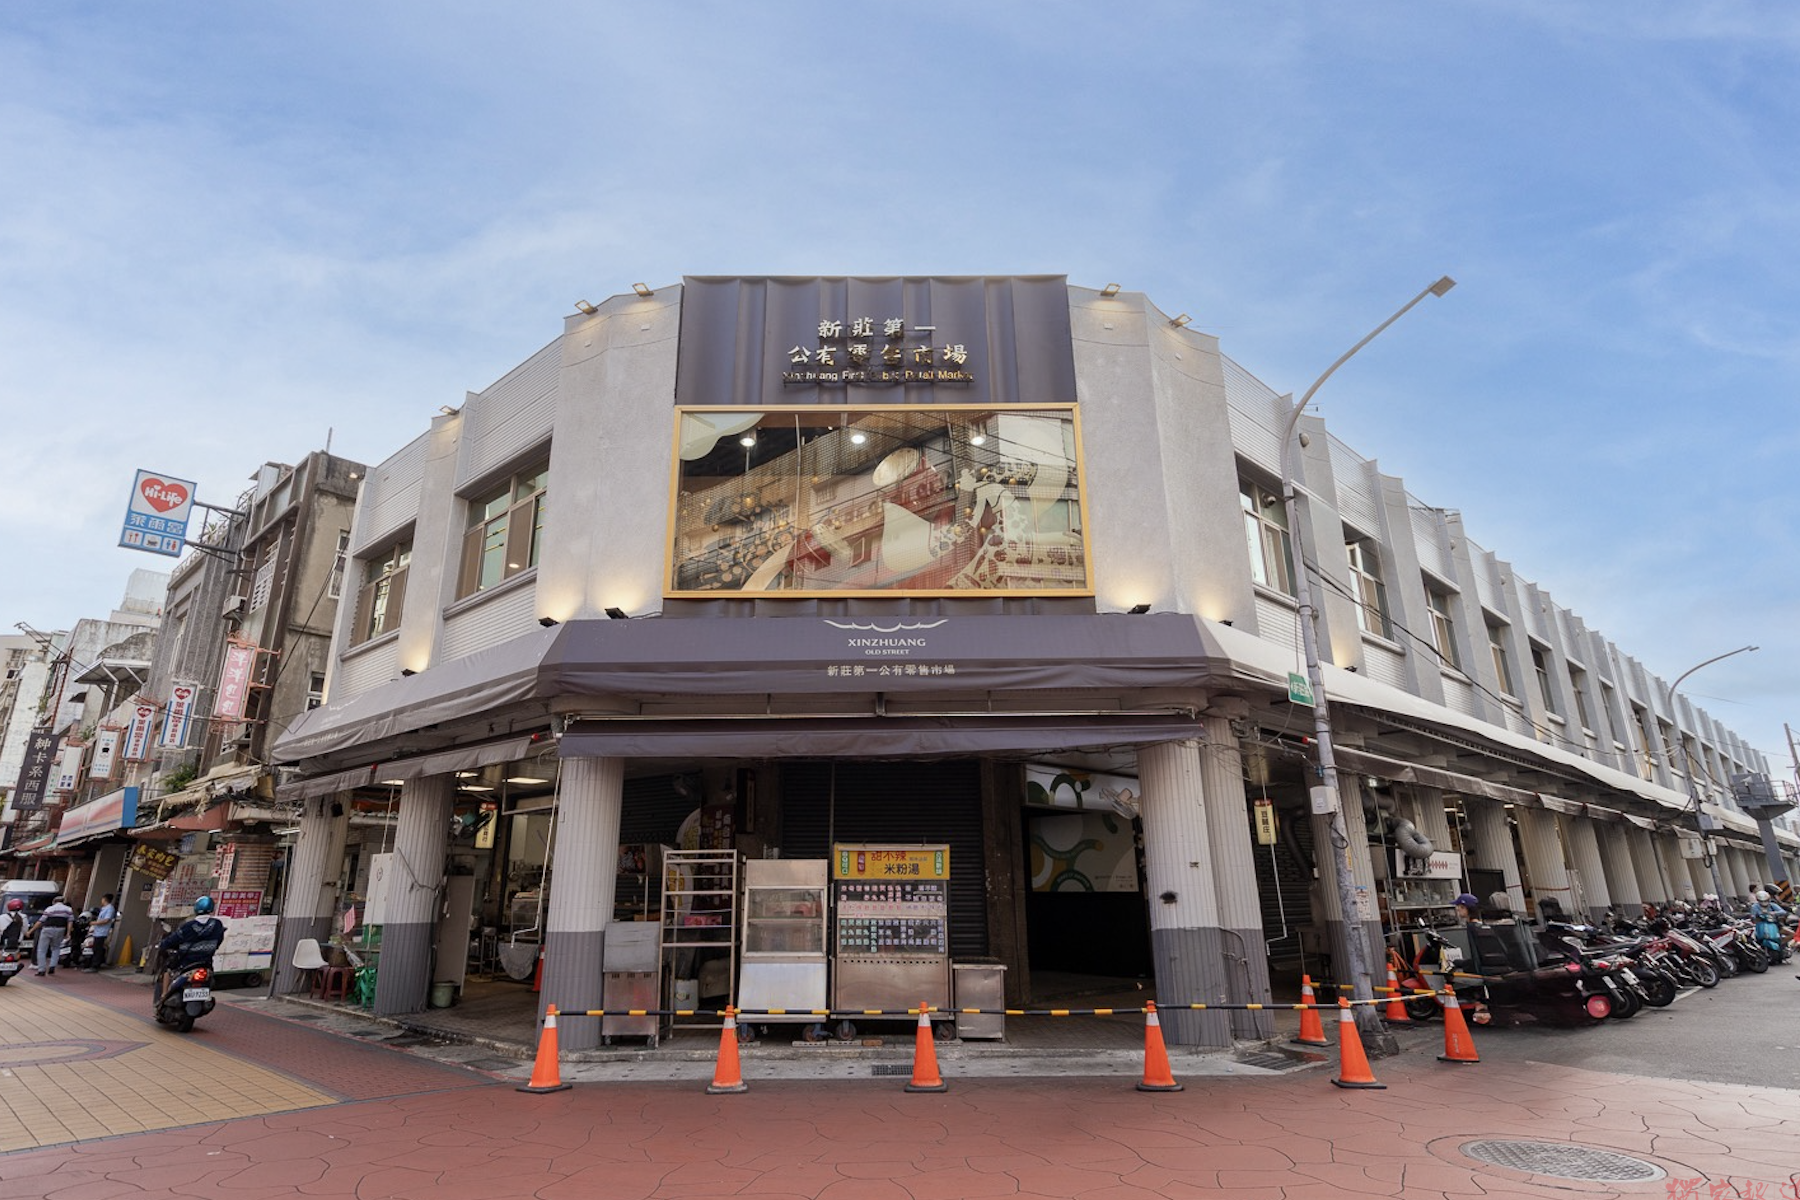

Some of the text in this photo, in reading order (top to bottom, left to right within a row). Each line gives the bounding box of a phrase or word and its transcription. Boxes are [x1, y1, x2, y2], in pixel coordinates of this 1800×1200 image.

[817, 317, 936, 338] 新莊第一
[144, 484, 183, 507] Hi-Life
[848, 638, 926, 647] XINZHUANG
[827, 664, 956, 677] 新莊第一公有零售市場
[884, 862, 920, 875] 米粉湯
